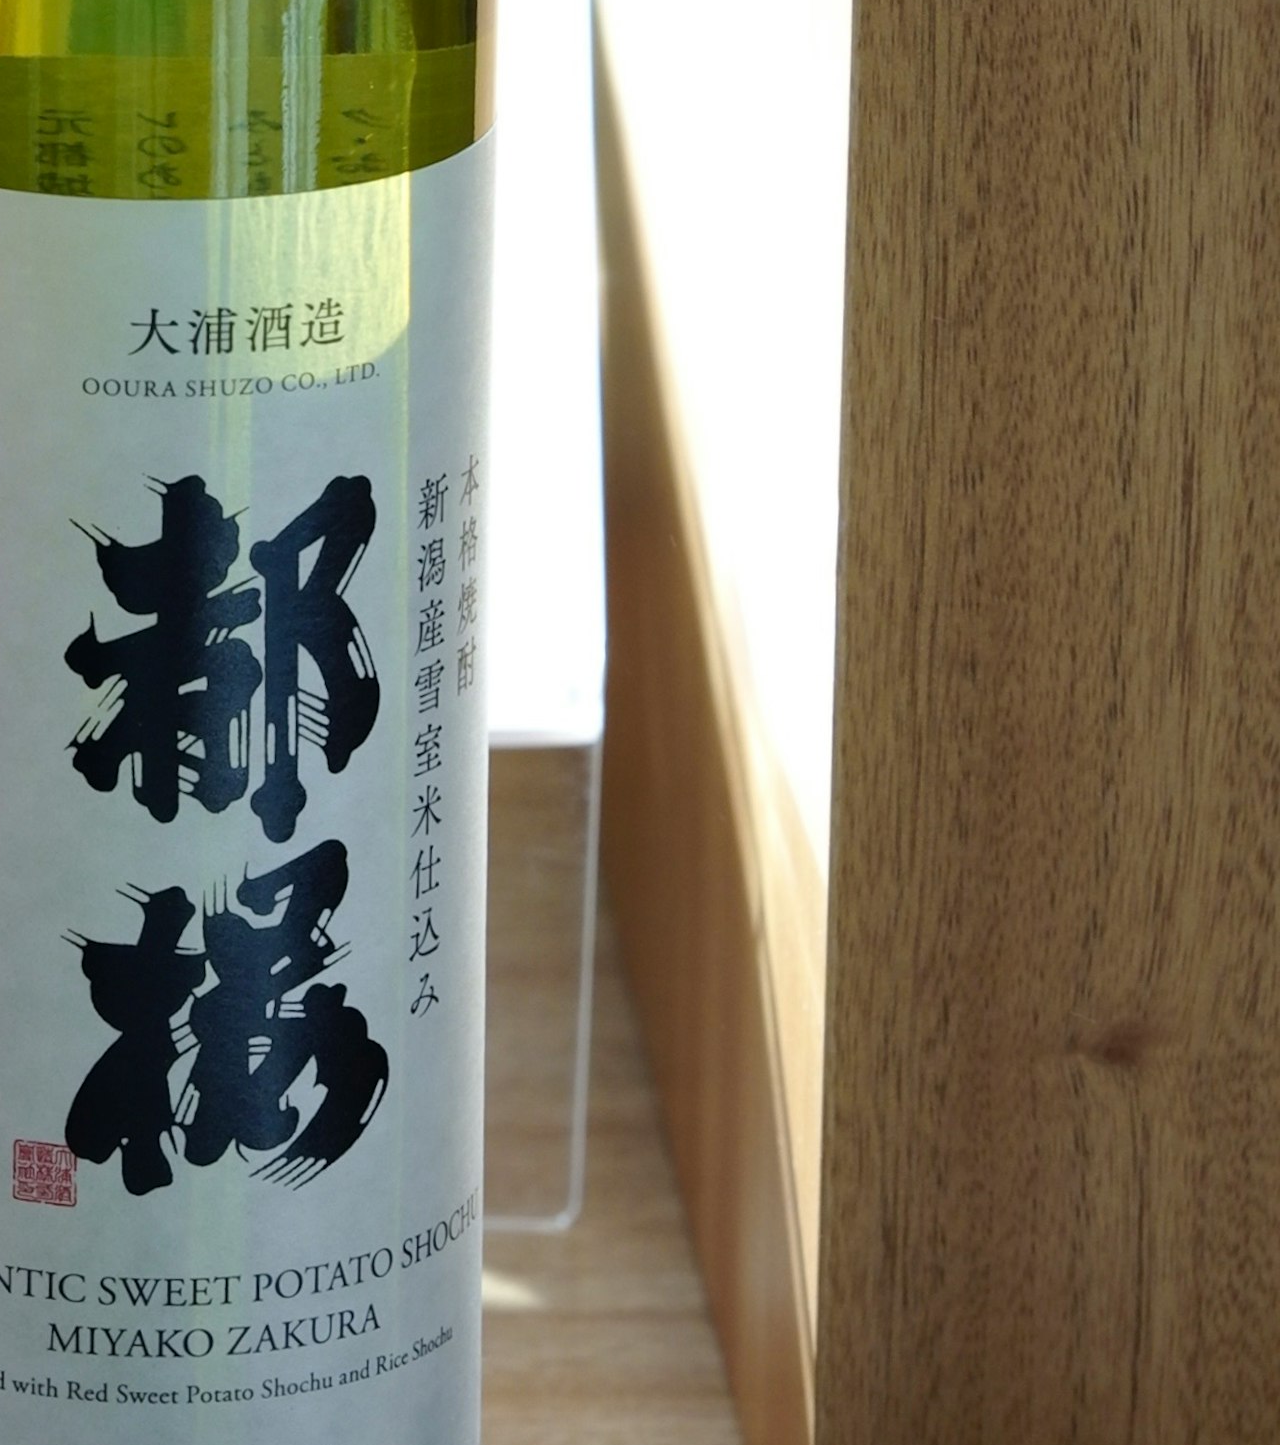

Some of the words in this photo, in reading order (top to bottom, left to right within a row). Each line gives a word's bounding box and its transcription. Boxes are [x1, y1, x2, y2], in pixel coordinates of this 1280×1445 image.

[128, 297, 345, 356] 大浦酒造
[81, 377, 177, 398] OOURA
[185, 377, 274, 398] SHUZO
[280, 371, 327, 393] CO.,
[335, 361, 381, 385] LTD.
[456, 455, 481, 697] 本格焼酎
[408, 472, 449, 1020] 新潟産雪室米仕込み
[97, 1274, 241, 1307] SWEET
[252, 1246, 394, 1303] POTATO
[401, 1188, 481, 1269] SHOCHU
[12, 1373, 59, 1399] with
[66, 1381, 109, 1403] Red
[116, 1383, 179, 1406] Sweet
[186, 1384, 255, 1405] Potato
[261, 1371, 334, 1399] Shochu
[338, 1359, 371, 1386] and
[375, 1347, 409, 1373] Rice
[411, 1324, 454, 1362] Shochu
[46, 1322, 215, 1359] MIYAKO
[226, 1303, 382, 1357] ZAKURA
